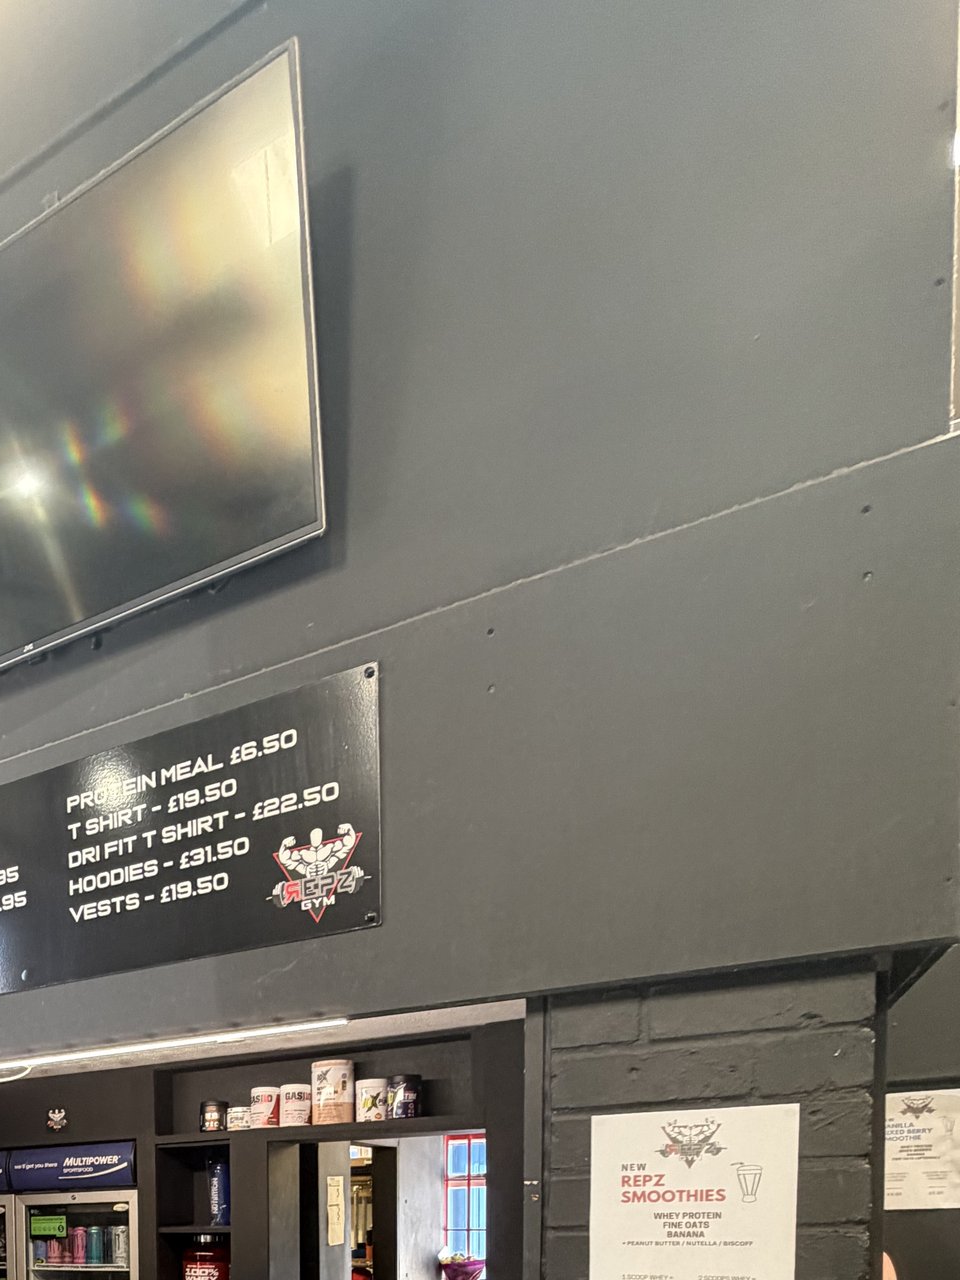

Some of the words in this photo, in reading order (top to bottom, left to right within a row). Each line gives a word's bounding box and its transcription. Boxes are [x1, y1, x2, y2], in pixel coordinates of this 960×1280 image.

[66, 771, 157, 813] PROEIN
[160, 754, 224, 785] MEAL
[230, 728, 298, 764] £6.50
[68, 822, 82, 840] T
[85, 803, 147, 835] SHIRT
[167, 778, 237, 814] £19.50
[68, 845, 100, 868] DRI
[104, 836, 137, 861] FIT
[142, 830, 157, 849] T
[161, 811, 229, 844] SHIRT
[252, 781, 339, 821] £22.50
[69, 859, 159, 895] HOODIES
[179, 836, 250, 870] £31.50
[284, 868, 353, 905] REPZ
[69, 893, 140, 923] VESTS
[160, 872, 229, 904] £19.50
[301, 895, 335, 910] GYM
[63, 1155, 119, 1167] MULTIPOWER
[621, 1163, 647, 1172] NEW
[621, 1174, 666, 1187] REPZ
[620, 1188, 727, 1203] SMOOTHIES
[682, 1211, 722, 1219] PROTEIN
[663, 1221, 683, 1229] FINE
[684, 1221, 710, 1229] OATS
[666, 1230, 705, 1238] BANANA
[185, 1268, 219, 1276] 100%
